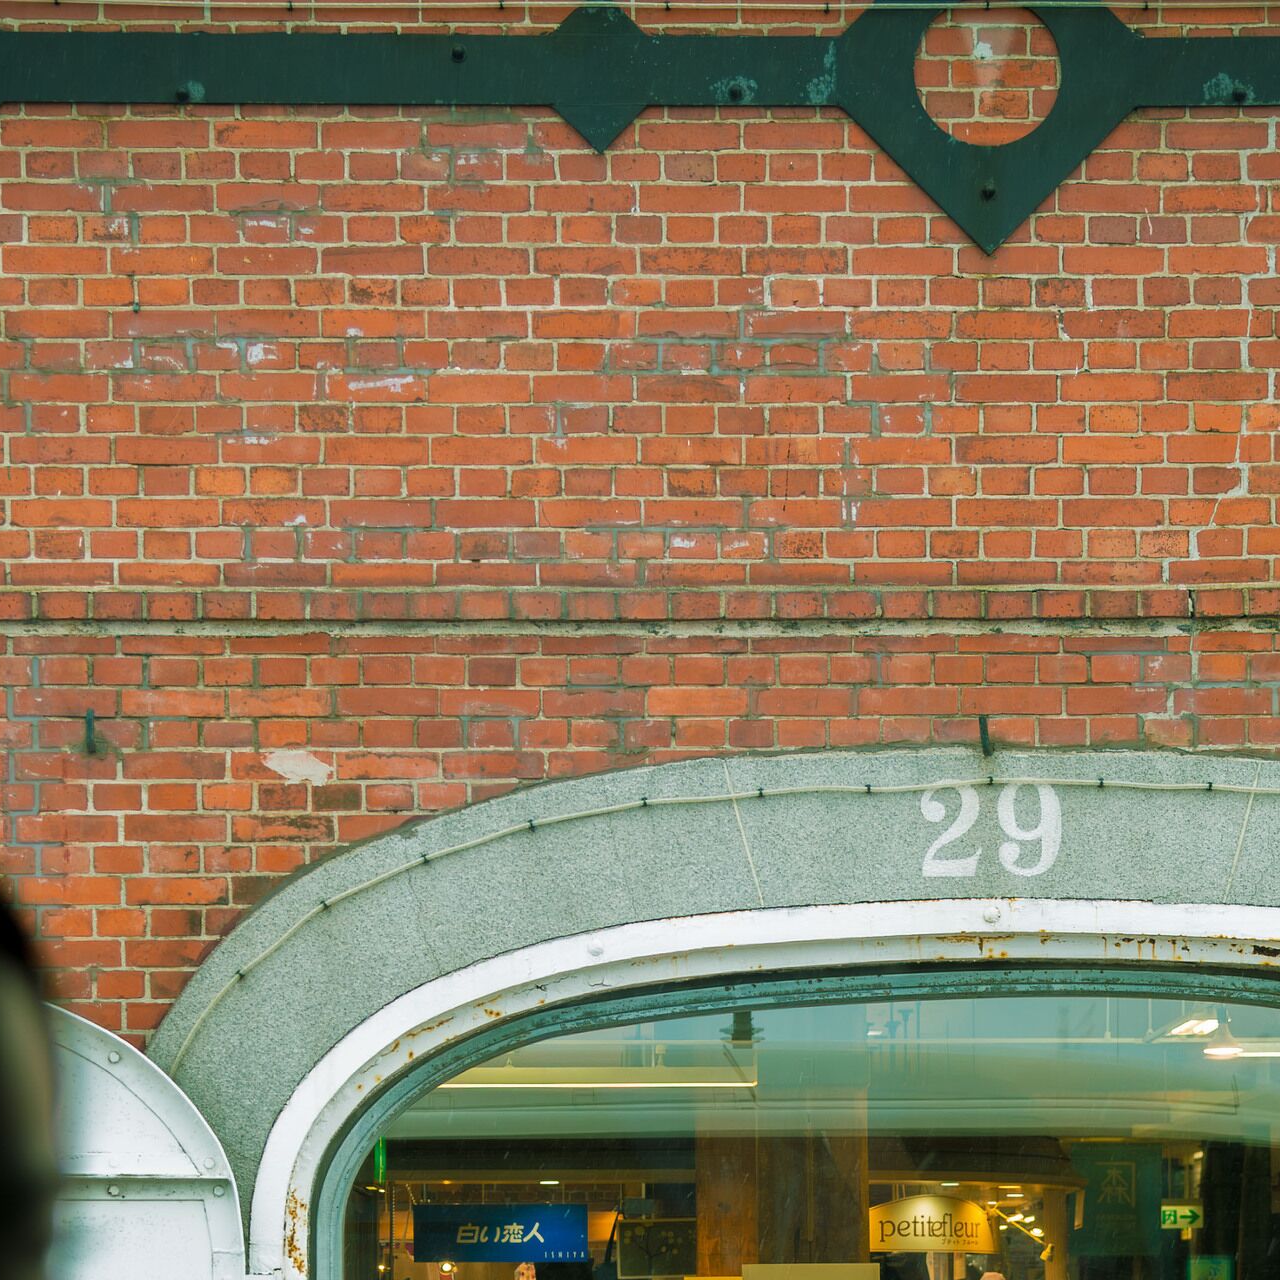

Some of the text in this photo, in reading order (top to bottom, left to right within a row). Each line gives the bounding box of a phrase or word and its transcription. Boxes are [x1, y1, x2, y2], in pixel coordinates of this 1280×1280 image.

[919, 780, 1062, 877] 29
[456, 1222, 545, 1244] 白い恋人
[878, 1212, 980, 1243] petitefleur
[544, 1251, 585, 1259] ISHIYA
